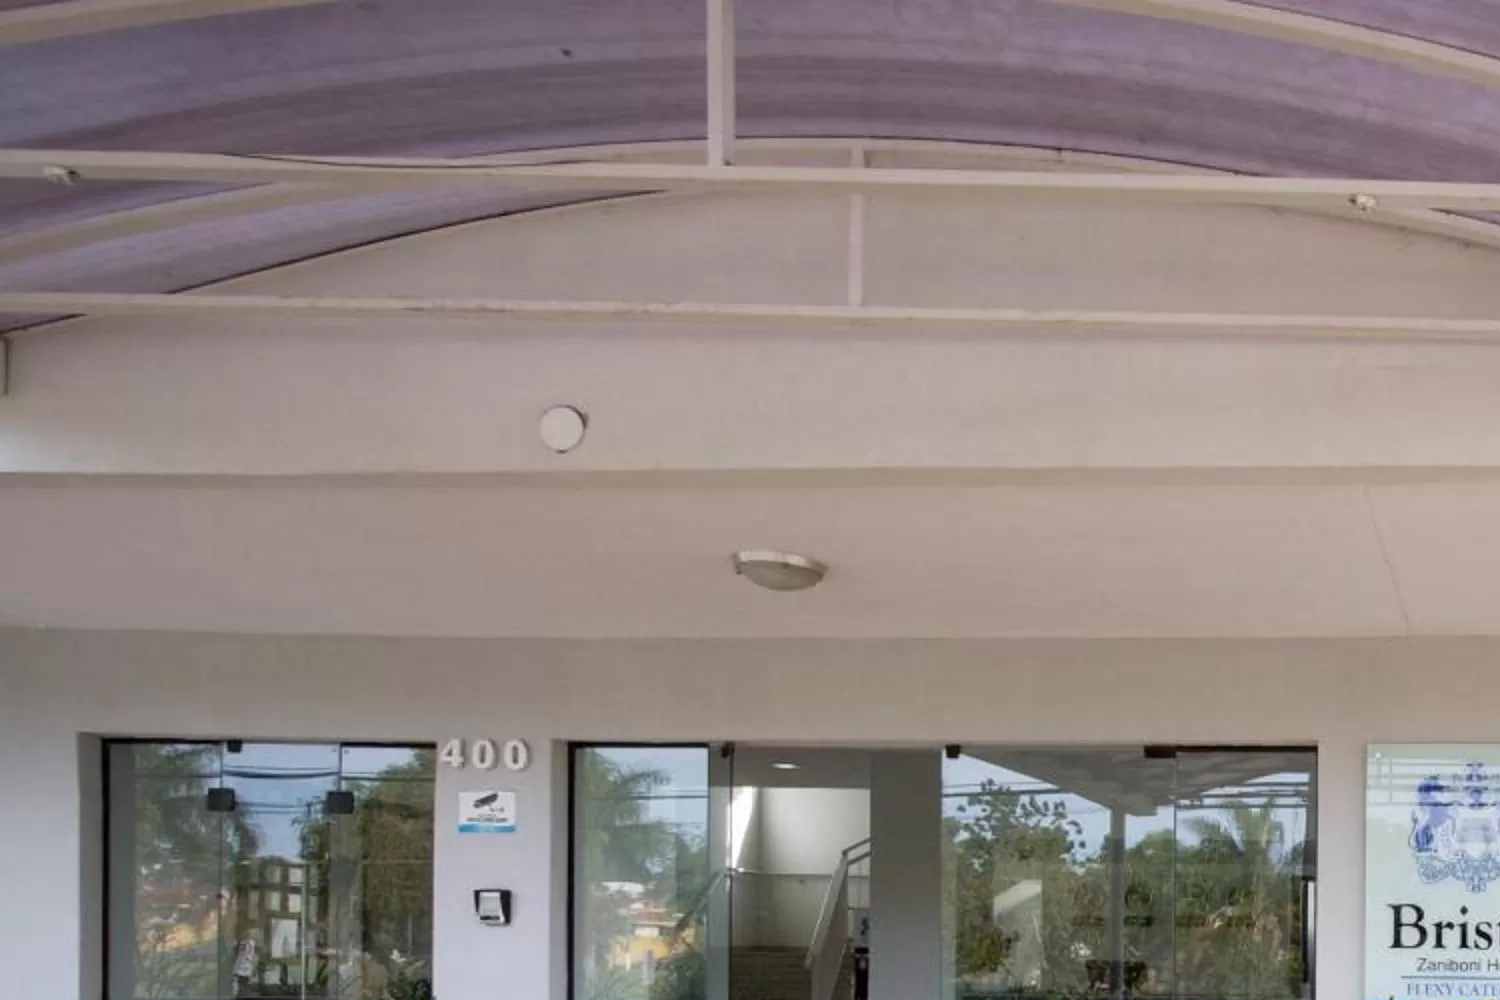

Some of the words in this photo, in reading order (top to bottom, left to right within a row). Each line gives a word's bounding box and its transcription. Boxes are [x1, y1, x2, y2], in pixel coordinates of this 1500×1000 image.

[440, 738, 529, 770] 400
[1416, 957, 1481, 973] Zaniboni
[1407, 983, 1454, 997] FLEXY
